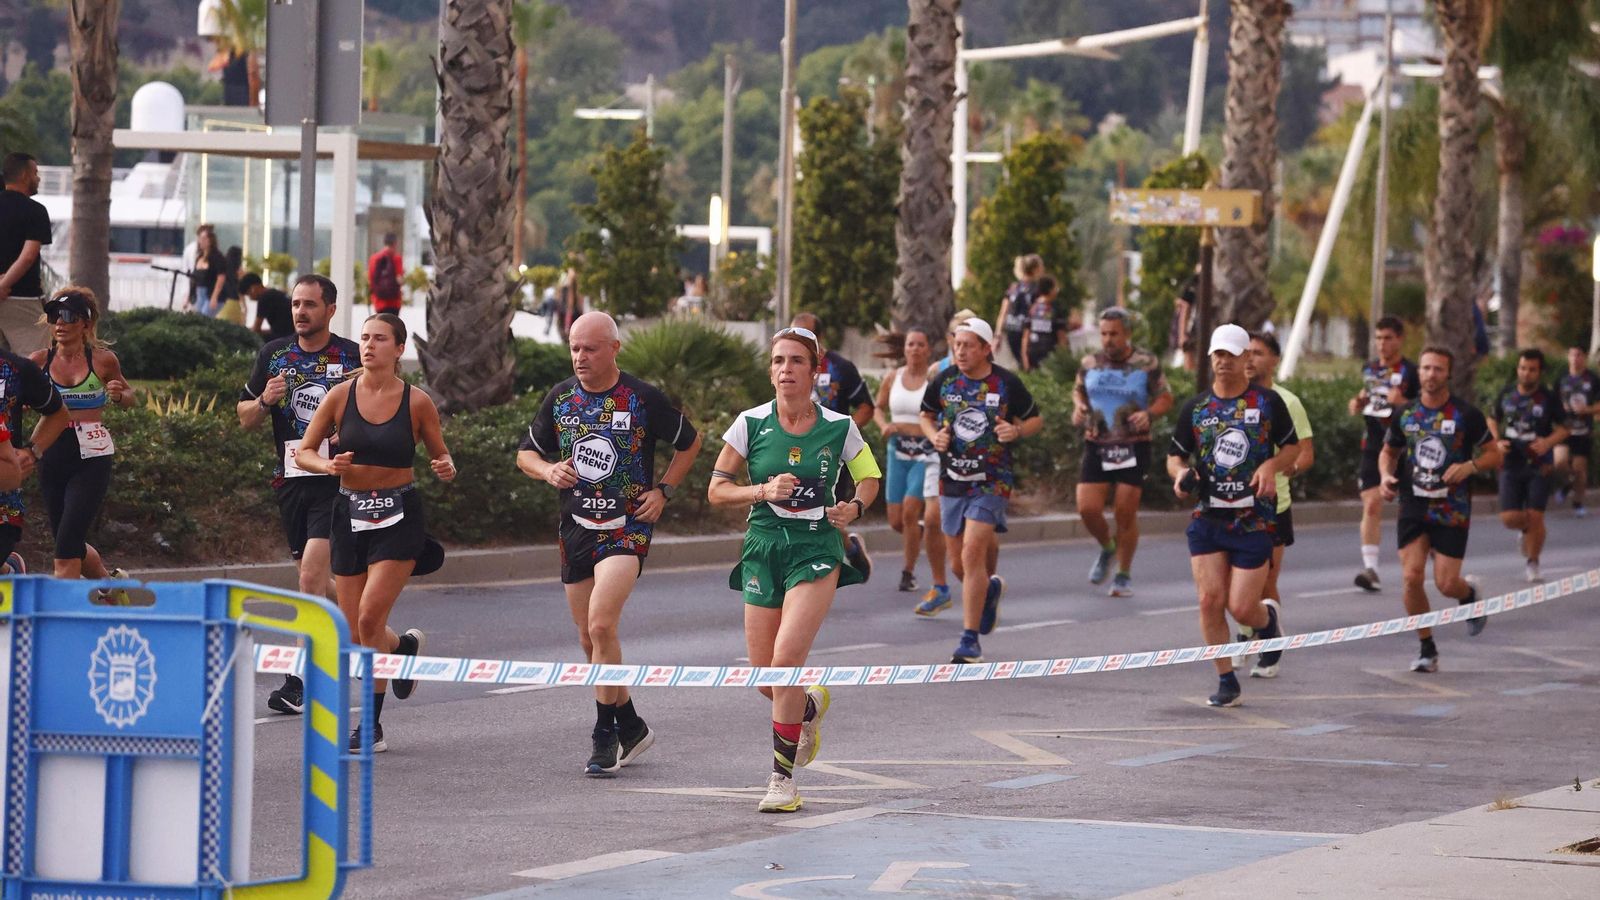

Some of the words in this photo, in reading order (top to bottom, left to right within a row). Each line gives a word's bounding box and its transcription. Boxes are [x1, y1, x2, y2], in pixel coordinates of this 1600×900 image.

[297, 392, 320, 404] PONL
[295, 400, 319, 411] FREN
[613, 420, 627, 429] AXA
[1220, 438, 1244, 451] PONLE
[578, 445, 612, 463] PONLE
[1218, 446, 1242, 458] FRENO
[576, 454, 608, 471] FRENO
[951, 457, 979, 468] 2975
[793, 486, 815, 498] 74
[1216, 481, 1244, 492] 2715
[357, 497, 394, 511] 2258
[582, 497, 616, 509] 2192
